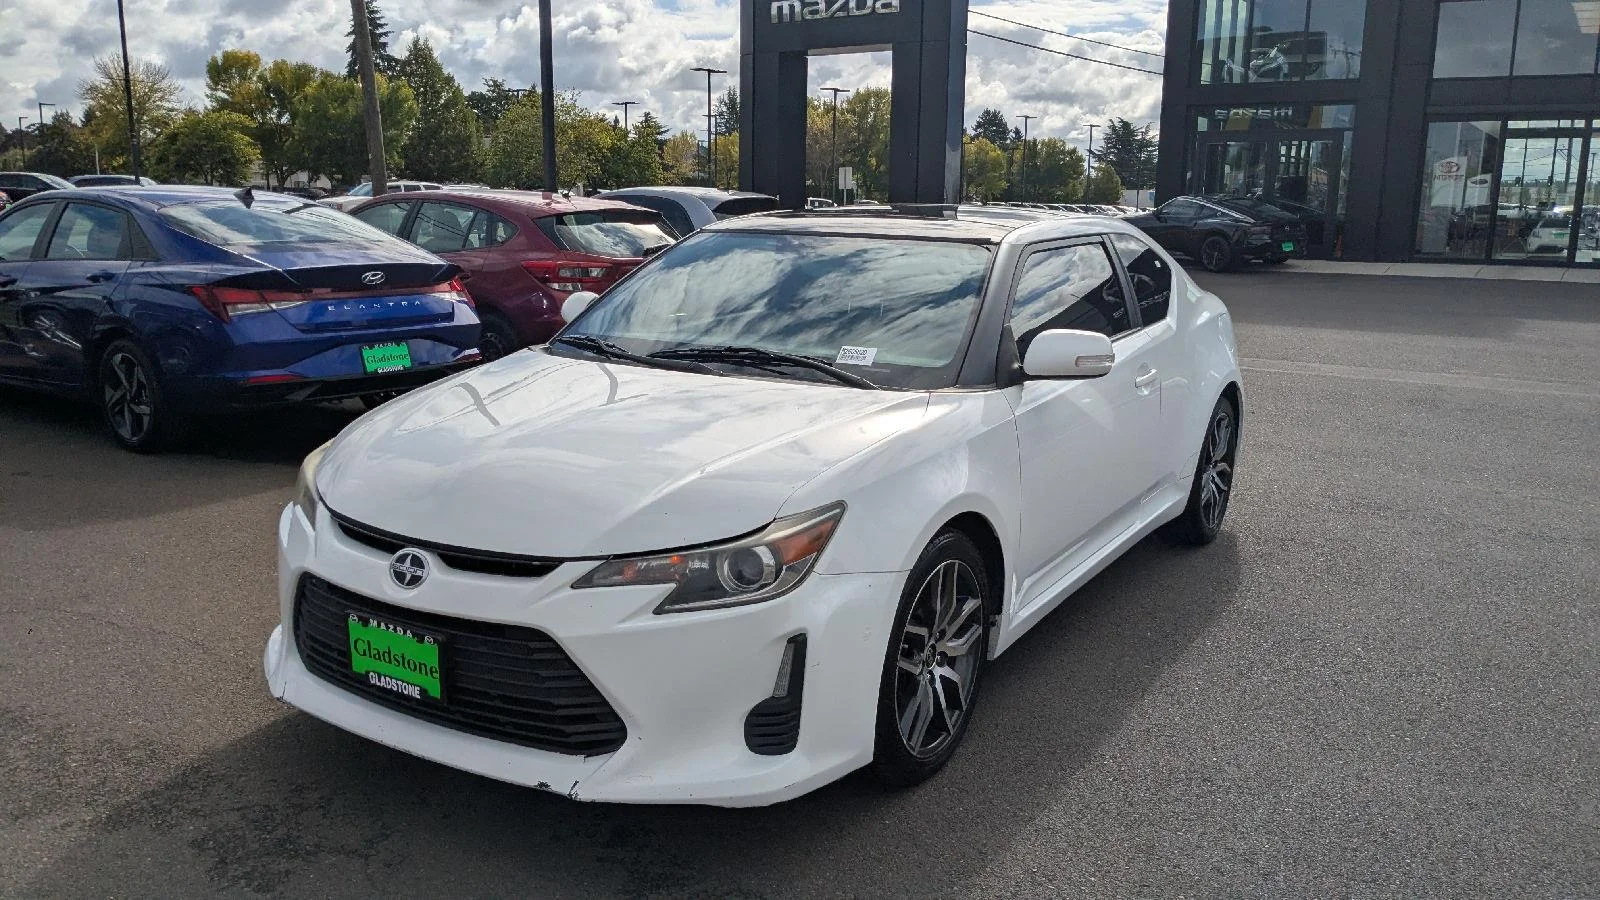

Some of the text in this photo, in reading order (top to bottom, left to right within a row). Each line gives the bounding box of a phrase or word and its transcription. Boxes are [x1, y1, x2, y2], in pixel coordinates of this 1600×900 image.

[328, 301, 420, 310] ELANTRA
[366, 354, 409, 364] Gladstone
[369, 619, 413, 638] MAZDA
[353, 638, 439, 679] Gladstone
[369, 672, 421, 699] GLADSTONE
